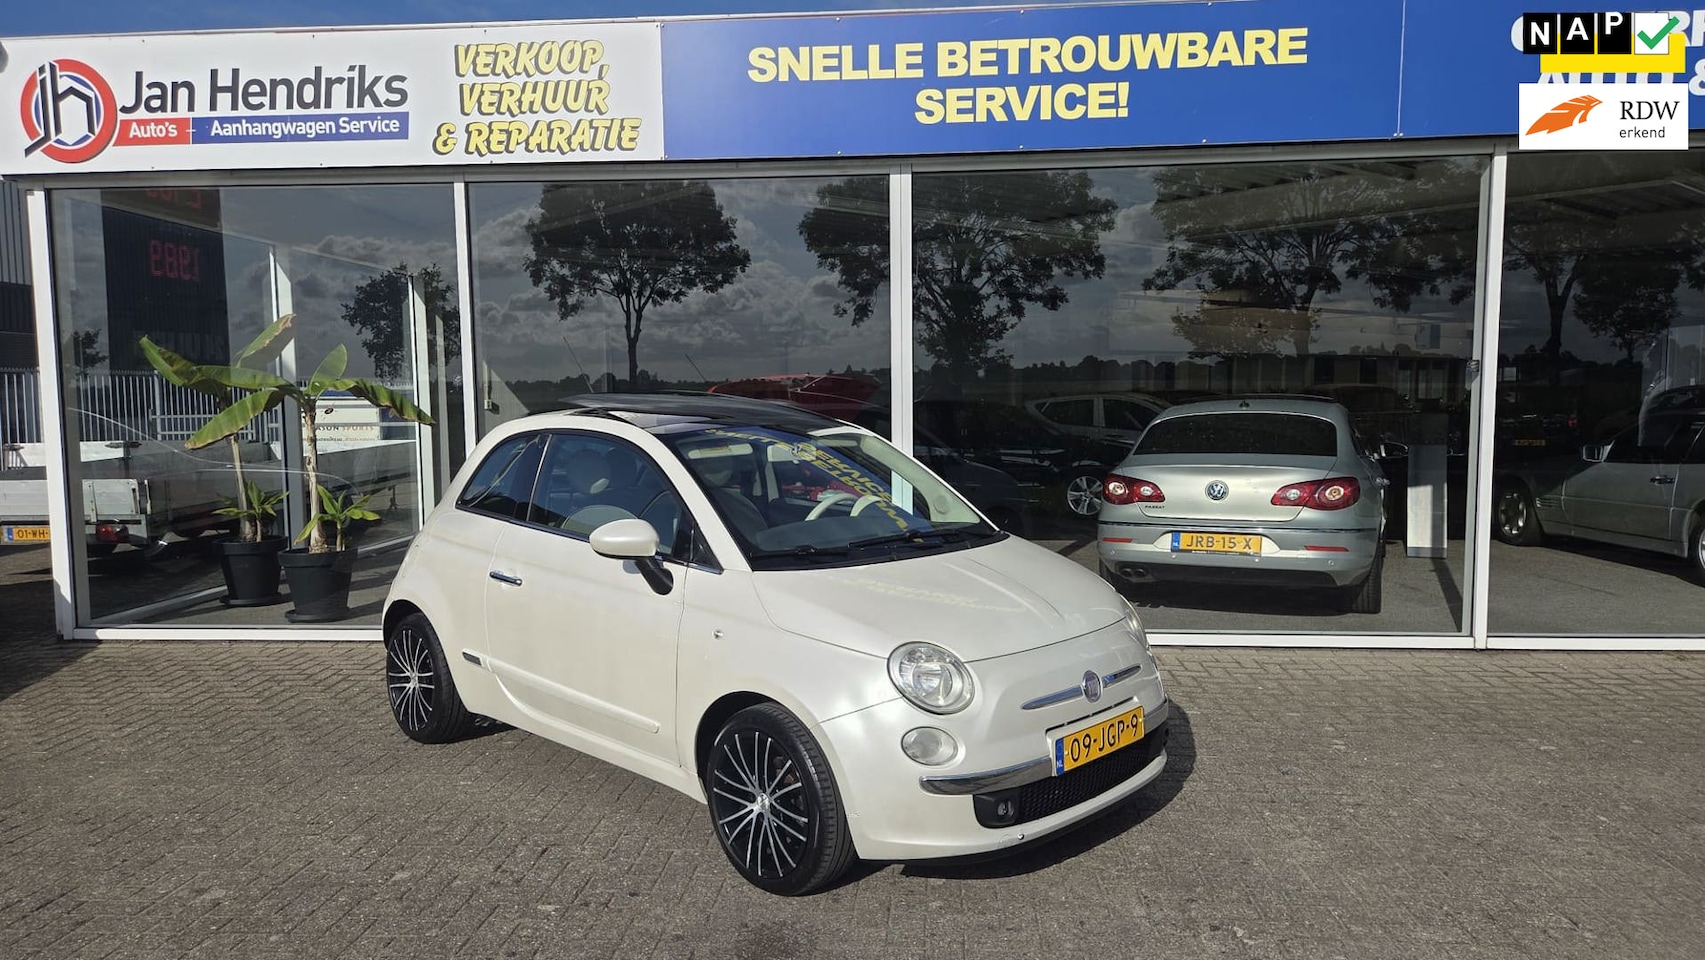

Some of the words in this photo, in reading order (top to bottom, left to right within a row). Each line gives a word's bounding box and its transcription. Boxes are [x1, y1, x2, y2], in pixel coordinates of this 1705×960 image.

[454, 39, 610, 80] VERKOOP,
[747, 42, 924, 83] SNELLE
[936, 27, 1308, 78] BETROUWBARE
[119, 71, 196, 114] Jan
[459, 79, 610, 117] VERHUUR
[914, 82, 1130, 125] SERVICE!
[129, 121, 178, 139] Auto's
[211, 118, 336, 139] Aanhangwagen
[339, 115, 400, 134] Service
[432, 122, 458, 155] &
[465, 118, 643, 157] REPARATIE
[1186, 534, 1253, 550] JRB-15-X
[1069, 714, 1139, 763] 09-JGP-9
